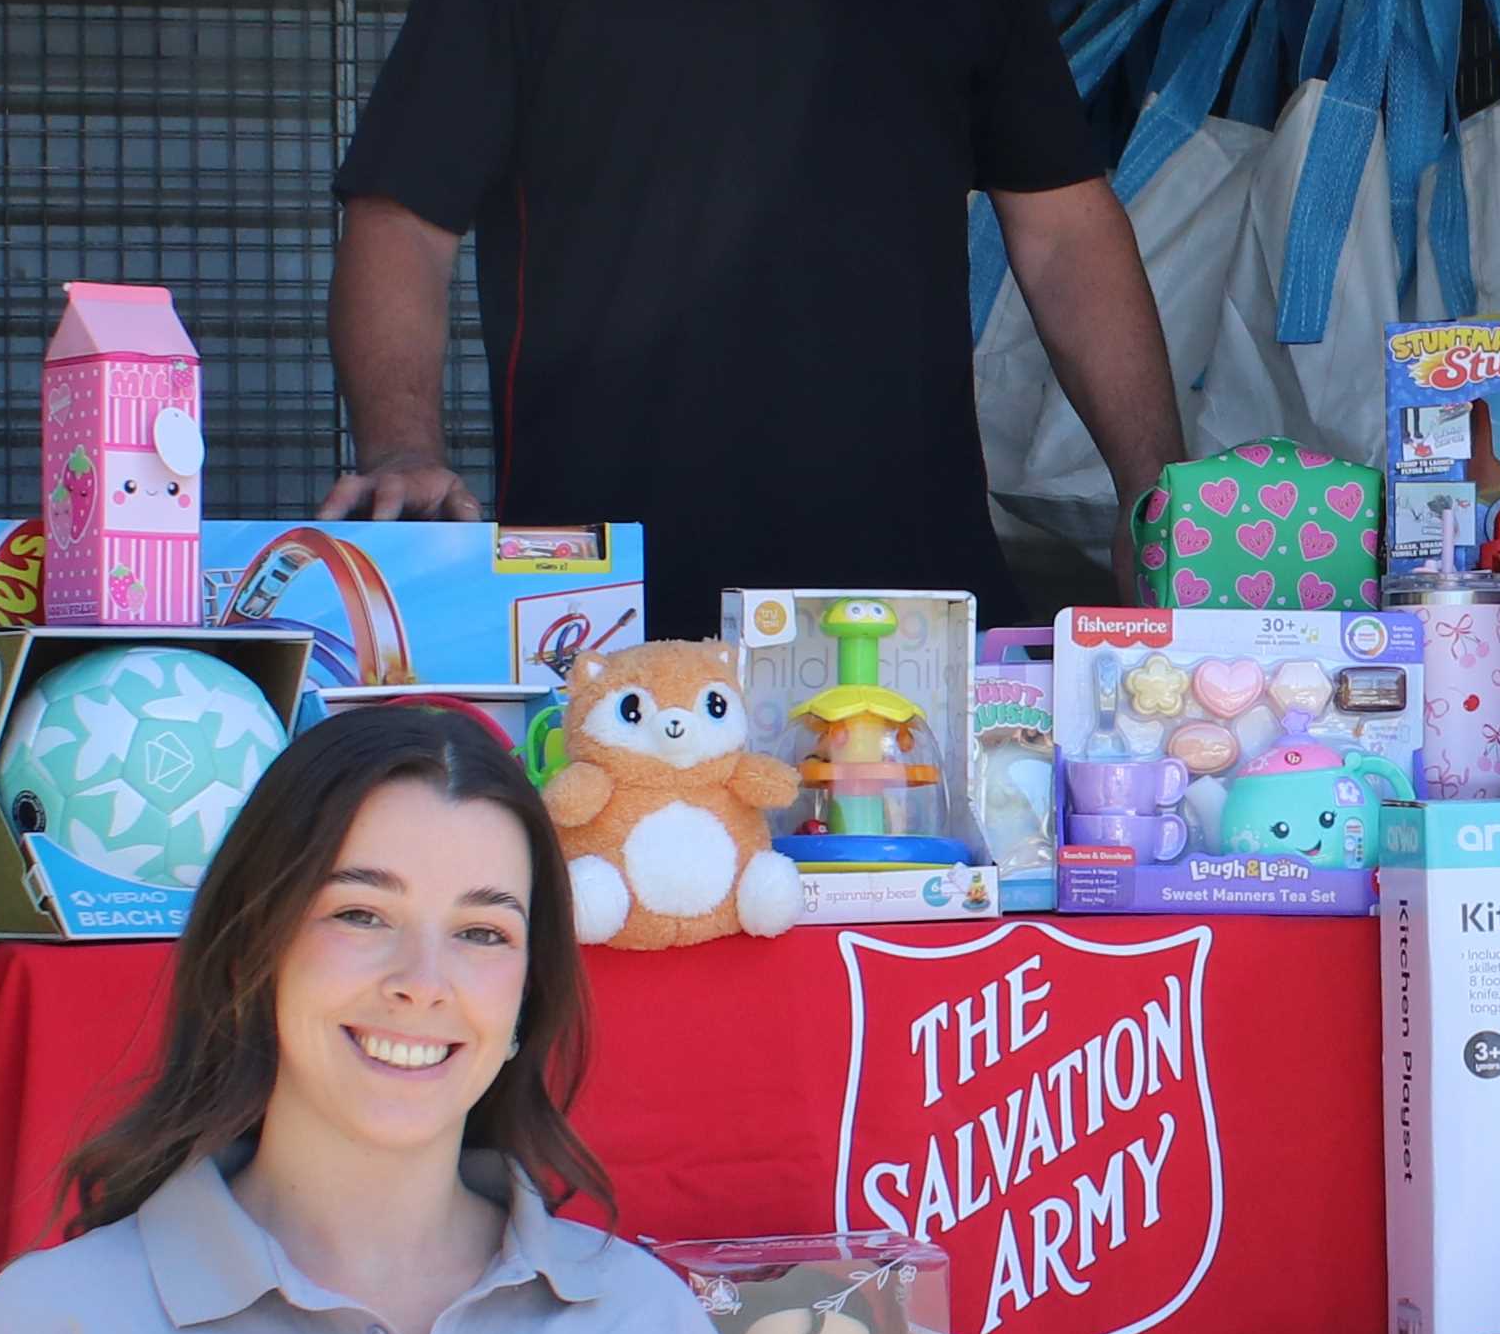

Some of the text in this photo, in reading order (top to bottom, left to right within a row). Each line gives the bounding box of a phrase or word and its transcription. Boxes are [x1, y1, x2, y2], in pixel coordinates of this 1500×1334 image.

[1077, 616, 1167, 635] fisher-price
[1261, 618, 1296, 633] 30+
[825, 887, 917, 904] spinning bees
[1162, 887, 1336, 904] Sweet Manners Tea Set
[79, 909, 164, 927] BEACH
[1469, 975, 1478, 987] 8
[911, 953, 1053, 1109] THE
[1398, 898, 1413, 1184] Kitchen Playset
[1473, 1041, 1500, 1061] 3+
[863, 975, 1183, 1244] SALVATION
